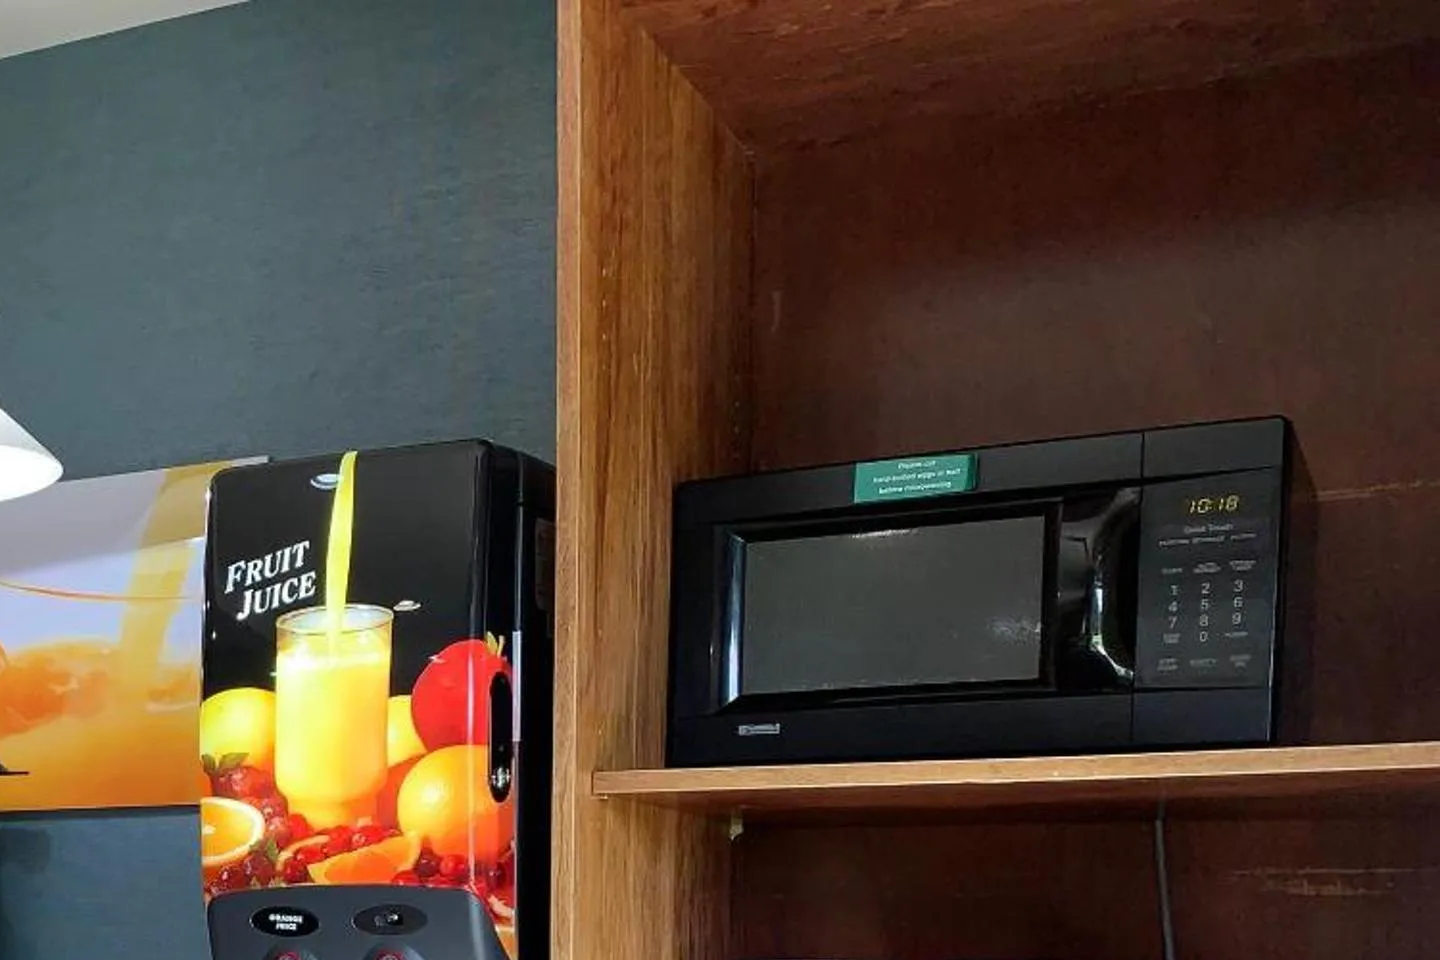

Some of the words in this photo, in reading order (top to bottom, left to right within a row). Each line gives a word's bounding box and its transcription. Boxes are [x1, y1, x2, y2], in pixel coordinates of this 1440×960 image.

[224, 540, 310, 594] FRUIT
[1201, 582, 1211, 594] 2
[1233, 579, 1244, 592] 3
[236, 571, 316, 621] JUICE
[1234, 596, 1244, 608] 6
[1201, 598, 1209, 611] 5
[1169, 615, 1178, 629] 7
[1200, 614, 1209, 627] 8
[1232, 612, 1242, 625] 9
[1199, 631, 1208, 642] 0
